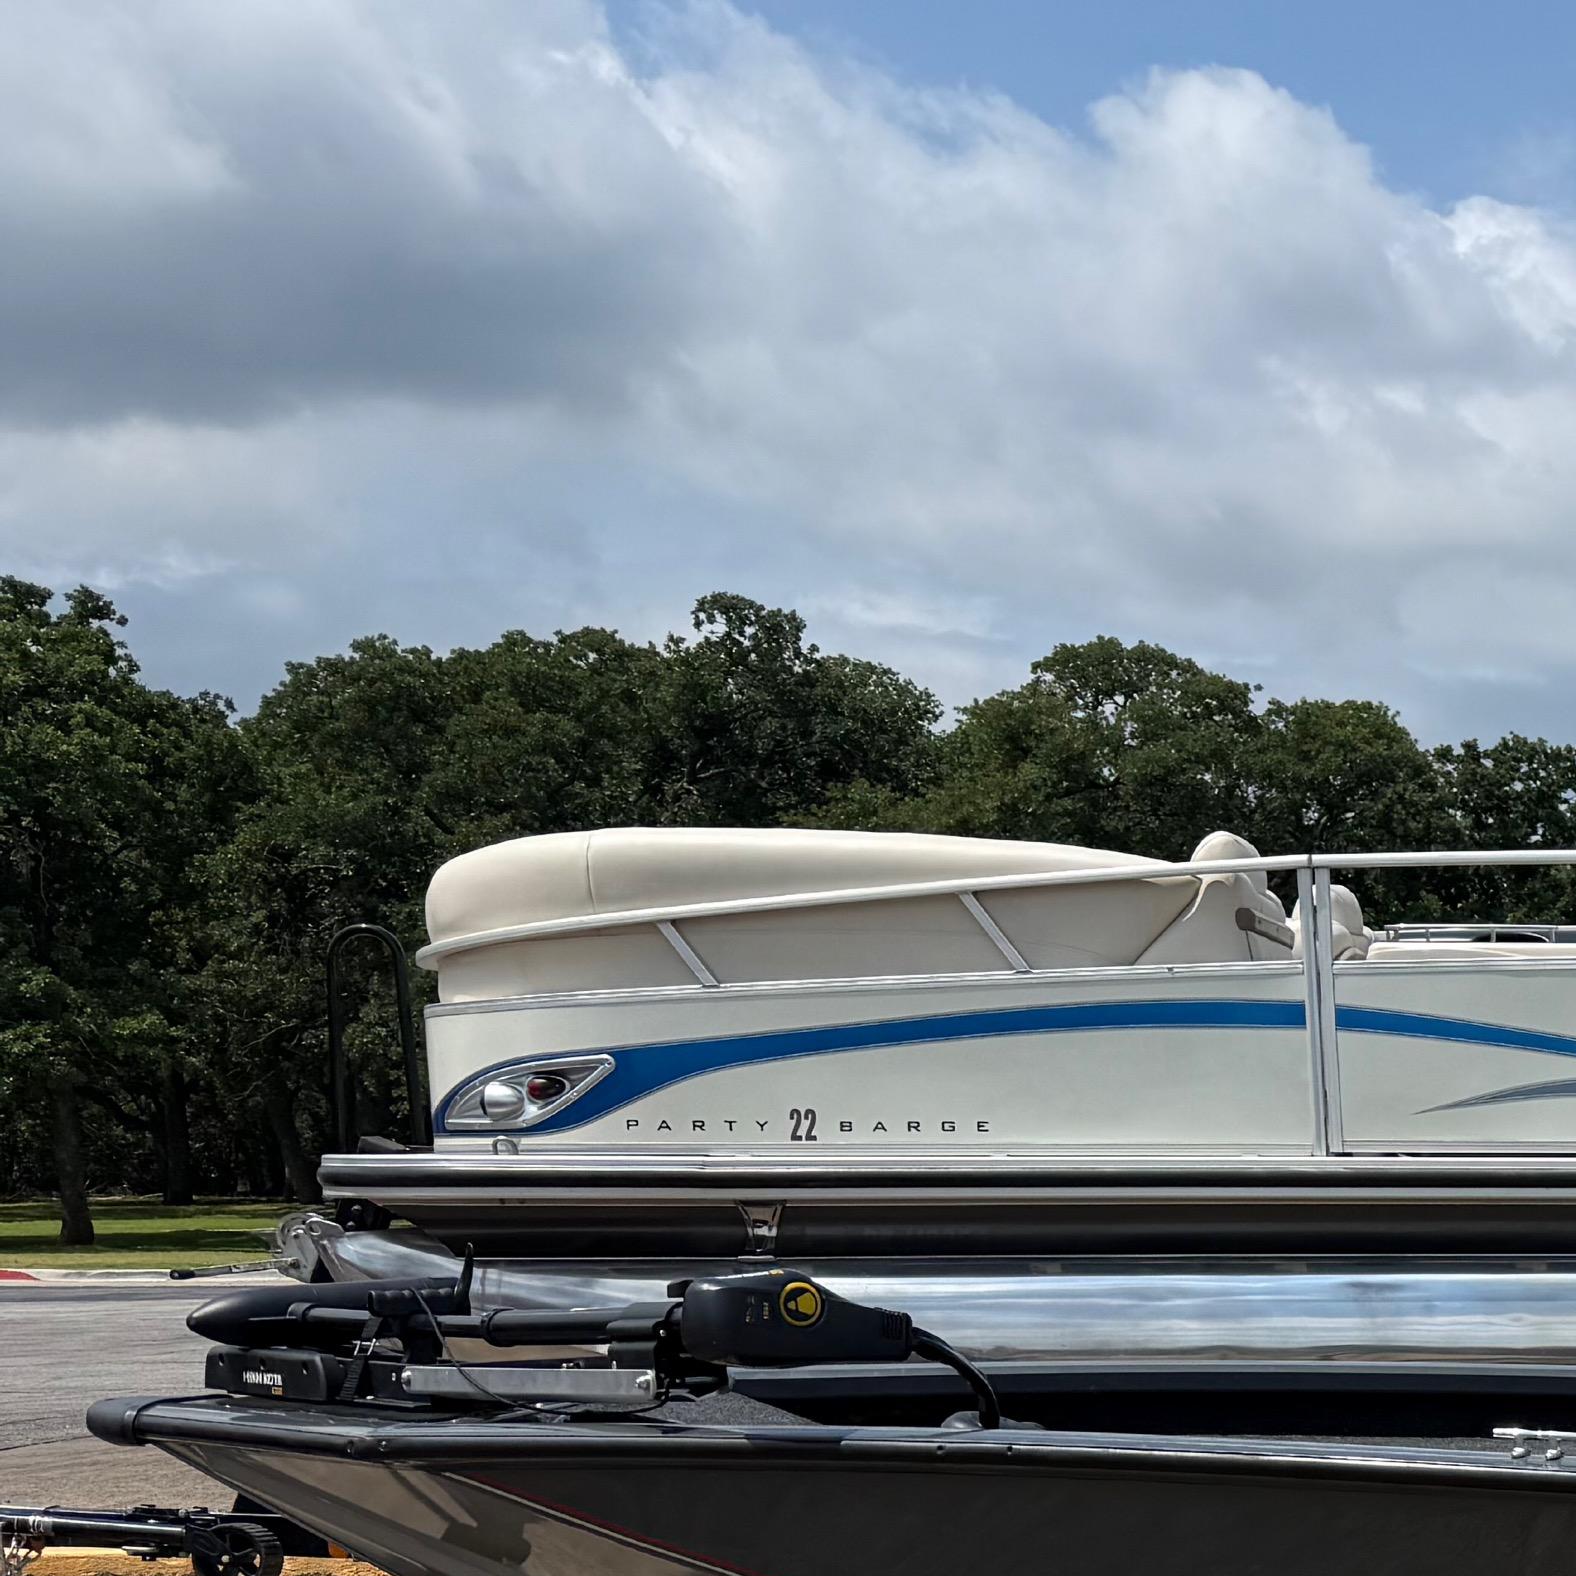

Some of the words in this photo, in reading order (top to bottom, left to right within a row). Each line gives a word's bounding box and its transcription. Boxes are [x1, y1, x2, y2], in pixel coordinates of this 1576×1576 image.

[626, 1119, 769, 1132] PARTY
[789, 1108, 818, 1141] 22
[840, 1120, 990, 1132] BARGE
